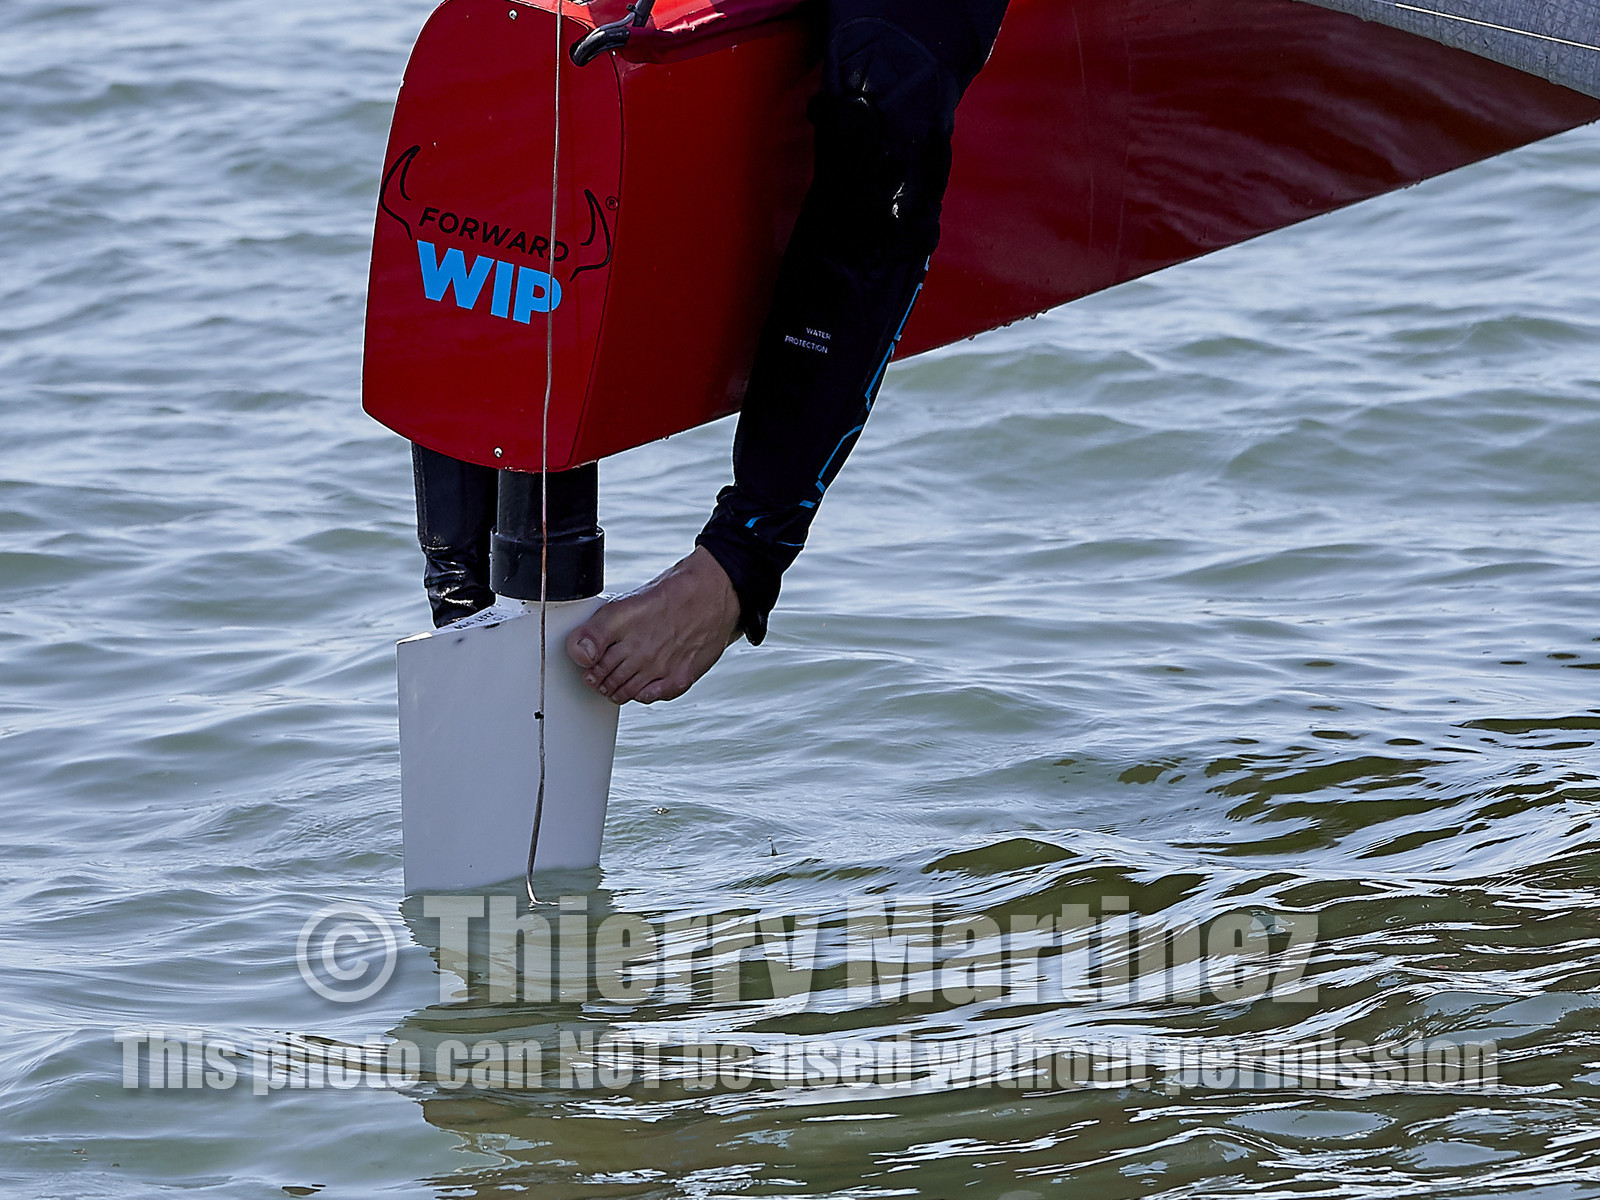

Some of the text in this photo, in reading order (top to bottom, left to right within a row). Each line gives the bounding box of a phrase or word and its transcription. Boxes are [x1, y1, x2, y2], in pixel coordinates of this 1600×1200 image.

[418, 206, 569, 262] FORWARD
[417, 239, 562, 325] WIP
[784, 335, 828, 354] PROTECTION
[806, 327, 832, 340] WATER
